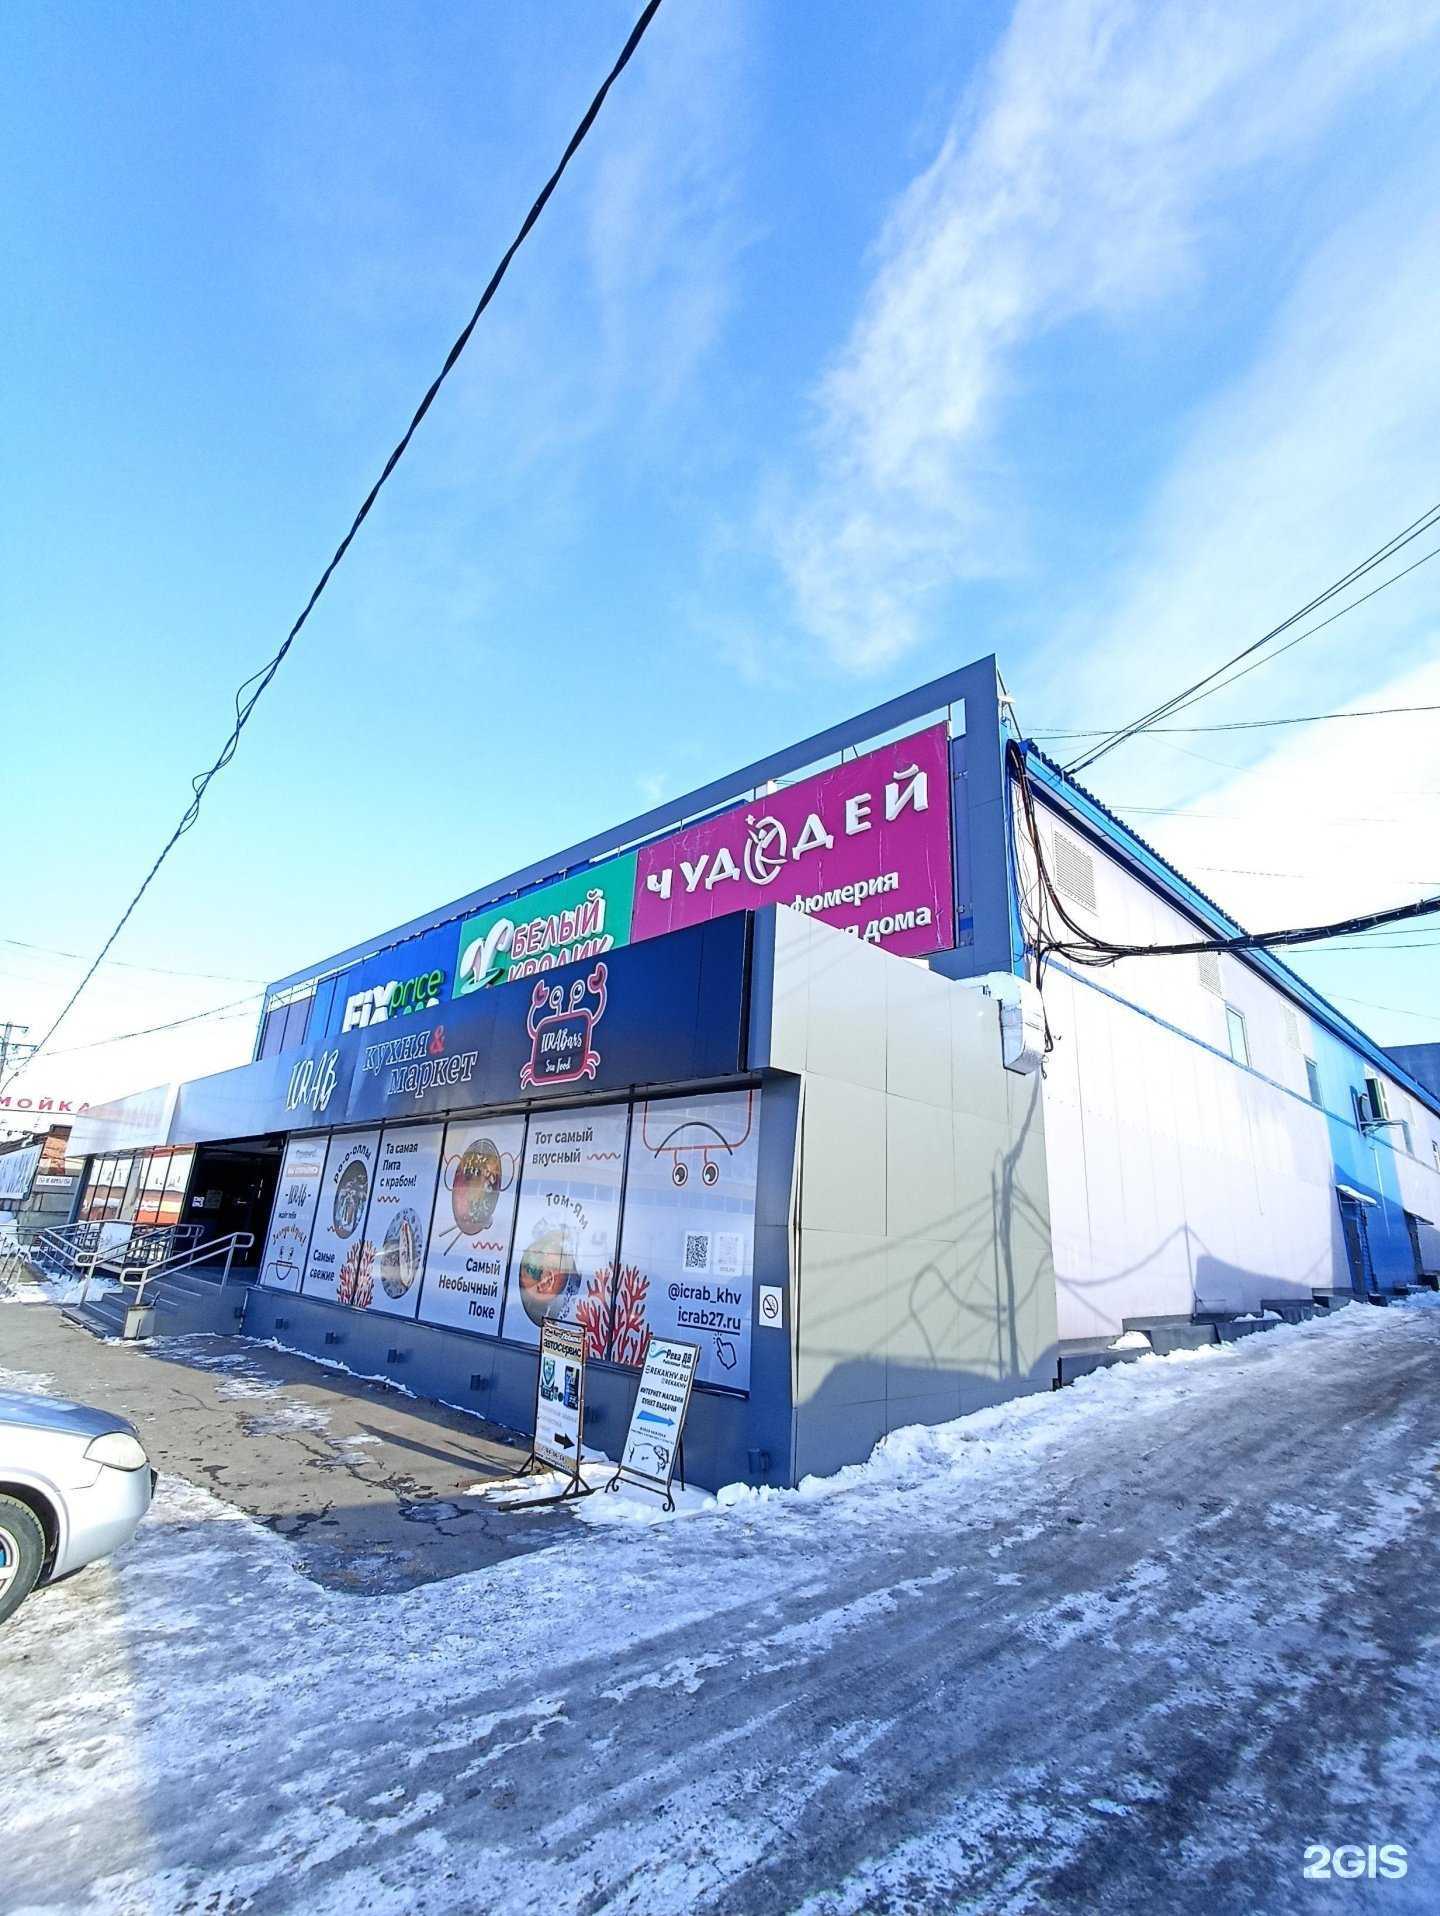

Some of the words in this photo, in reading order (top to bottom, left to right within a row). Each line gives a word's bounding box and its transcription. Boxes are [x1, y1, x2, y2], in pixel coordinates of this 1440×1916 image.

[646, 763, 929, 899] ЧУДОДЕЙ
[511, 888, 606, 960] БЕЛЫЙ
[863, 906, 932, 943] дома
[362, 1030, 431, 1076] кухня
[387, 1051, 478, 1099] маркет
[535, 1131, 552, 1145] Тот
[554, 1127, 593, 1143] самый
[386, 1143, 395, 1155] Та
[395, 1143, 419, 1154] самая
[532, 1148, 581, 1167] вкусный
[382, 1159, 401, 1171] Пита
[385, 1174, 417, 1190] крабом!
[313, 1249, 335, 1264] Самые
[309, 1268, 335, 1281] свежие
[466, 1257, 501, 1276] Самый
[438, 1273, 498, 1298] Необычный
[668, 1282, 742, 1305] @icrab_khv
[468, 1300, 495, 1319] Поке
[678, 1305, 741, 1331] icrab27.ru
[543, 1338, 582, 1358] автосервис
